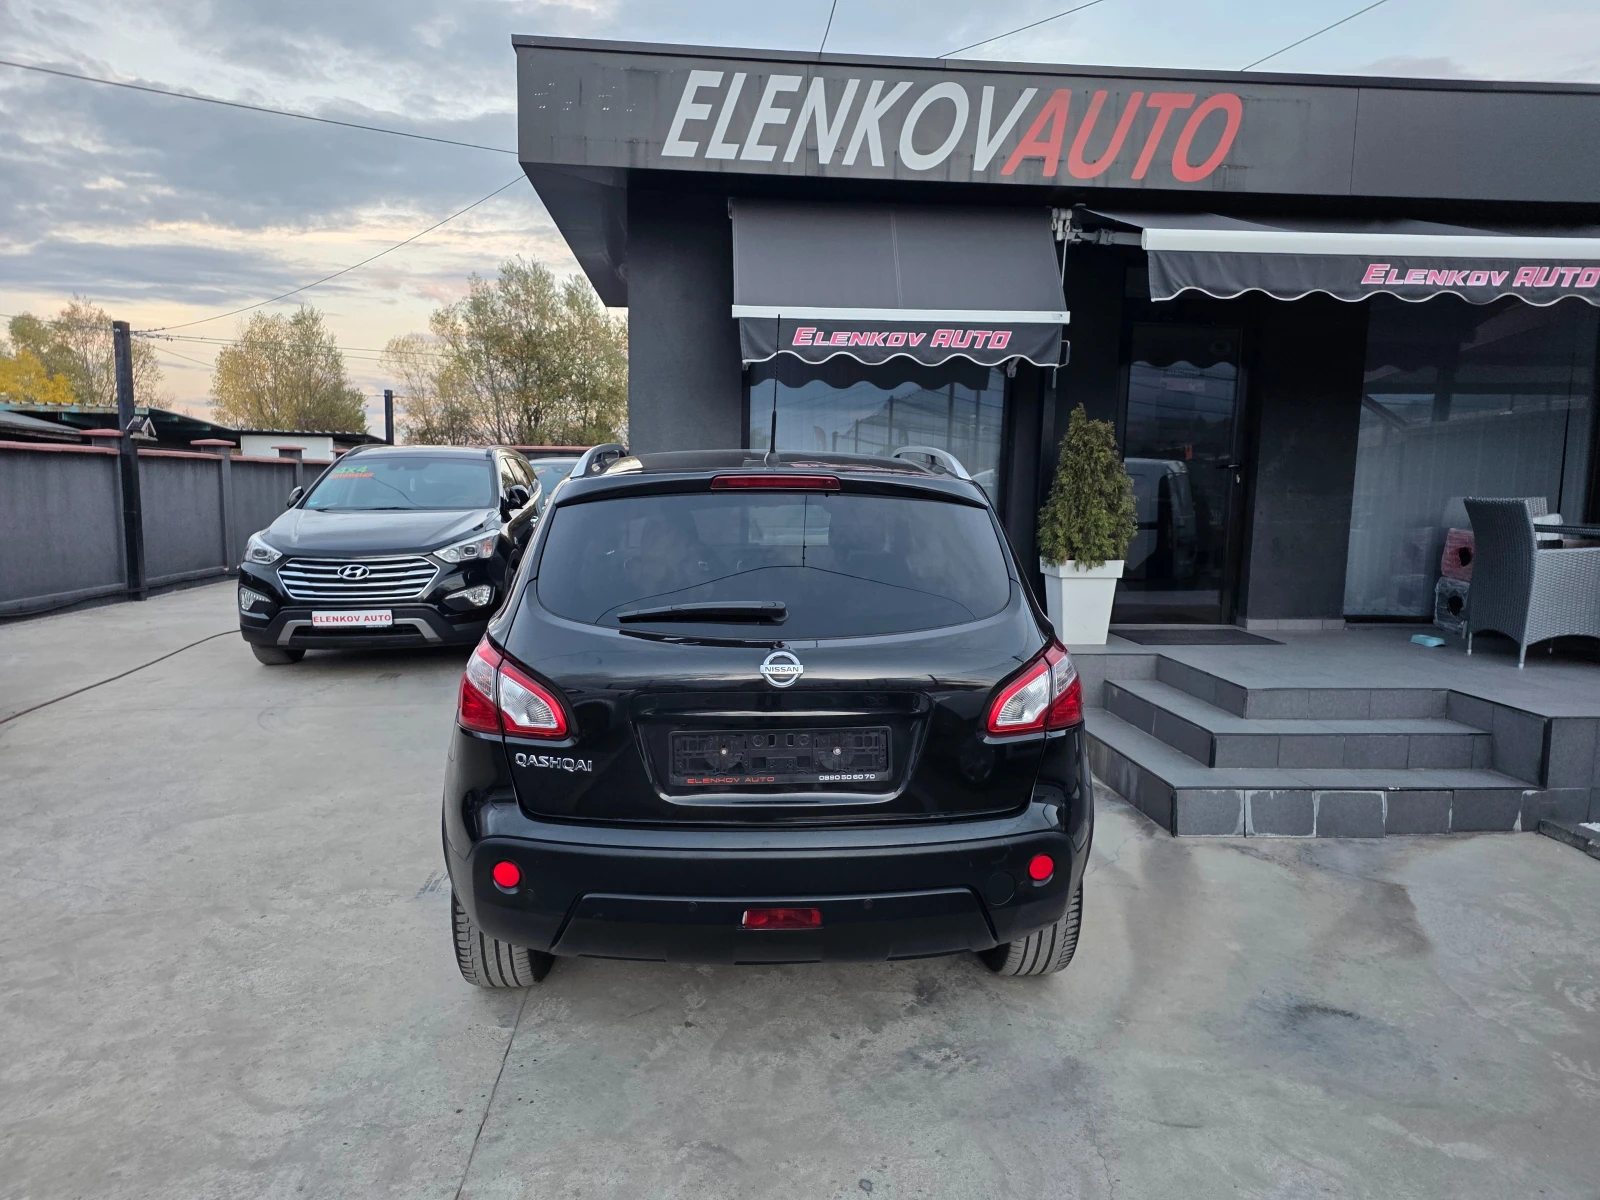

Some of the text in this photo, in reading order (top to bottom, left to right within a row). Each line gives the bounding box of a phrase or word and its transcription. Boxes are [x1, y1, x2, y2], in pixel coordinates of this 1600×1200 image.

[1361, 263, 1600, 288] ELENKOV AUTO
[792, 327, 1012, 349] ELENKOV AUTO
[515, 752, 593, 772] QASHQAI
